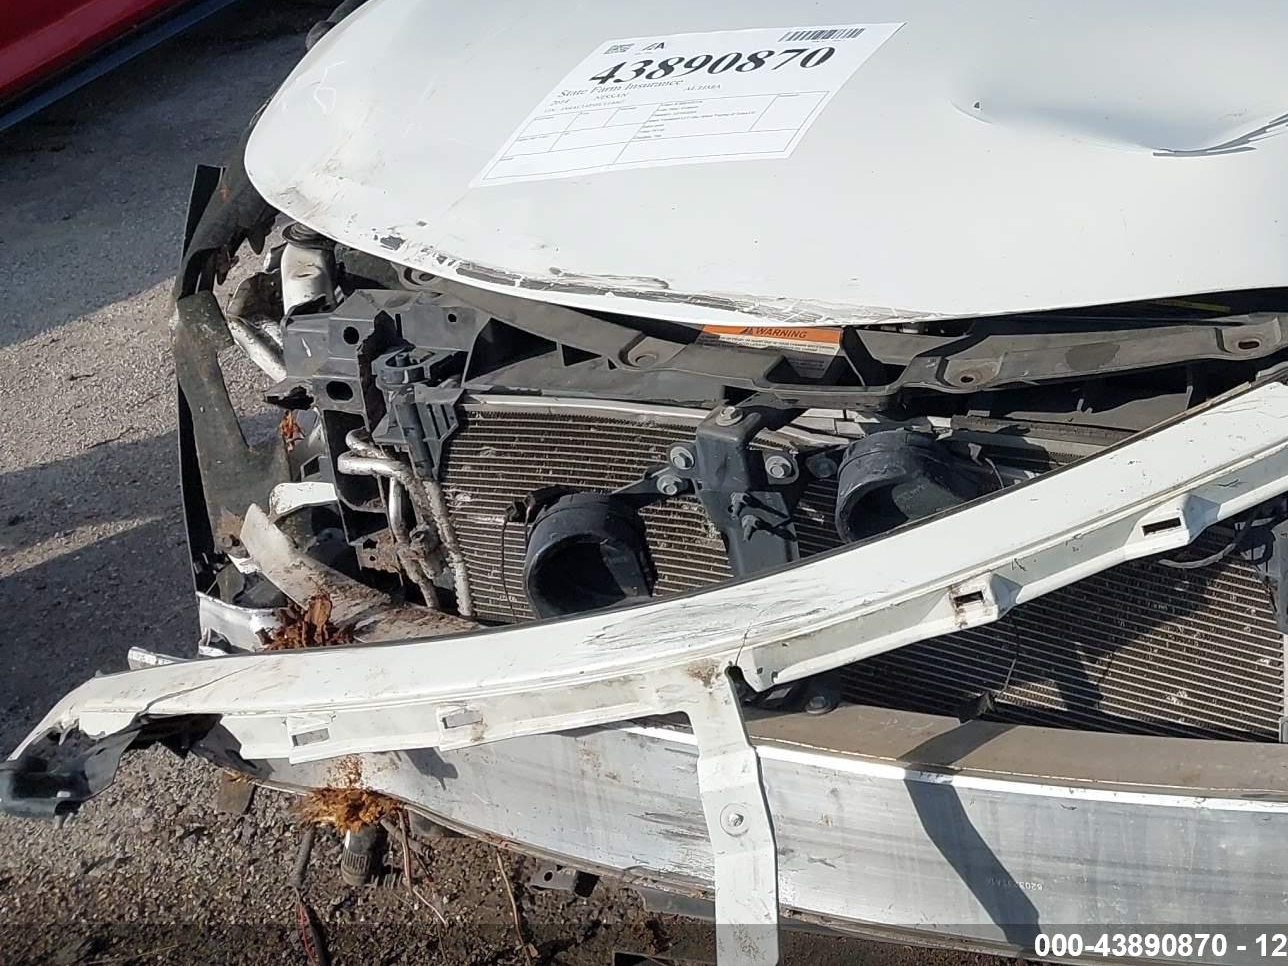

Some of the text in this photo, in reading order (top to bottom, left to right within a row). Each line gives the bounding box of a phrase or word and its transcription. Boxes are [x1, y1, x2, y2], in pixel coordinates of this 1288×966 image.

[588, 47, 836, 85] 43890870
[558, 80, 684, 97] State Farm Insurance
[754, 327, 808, 339] WARNING
